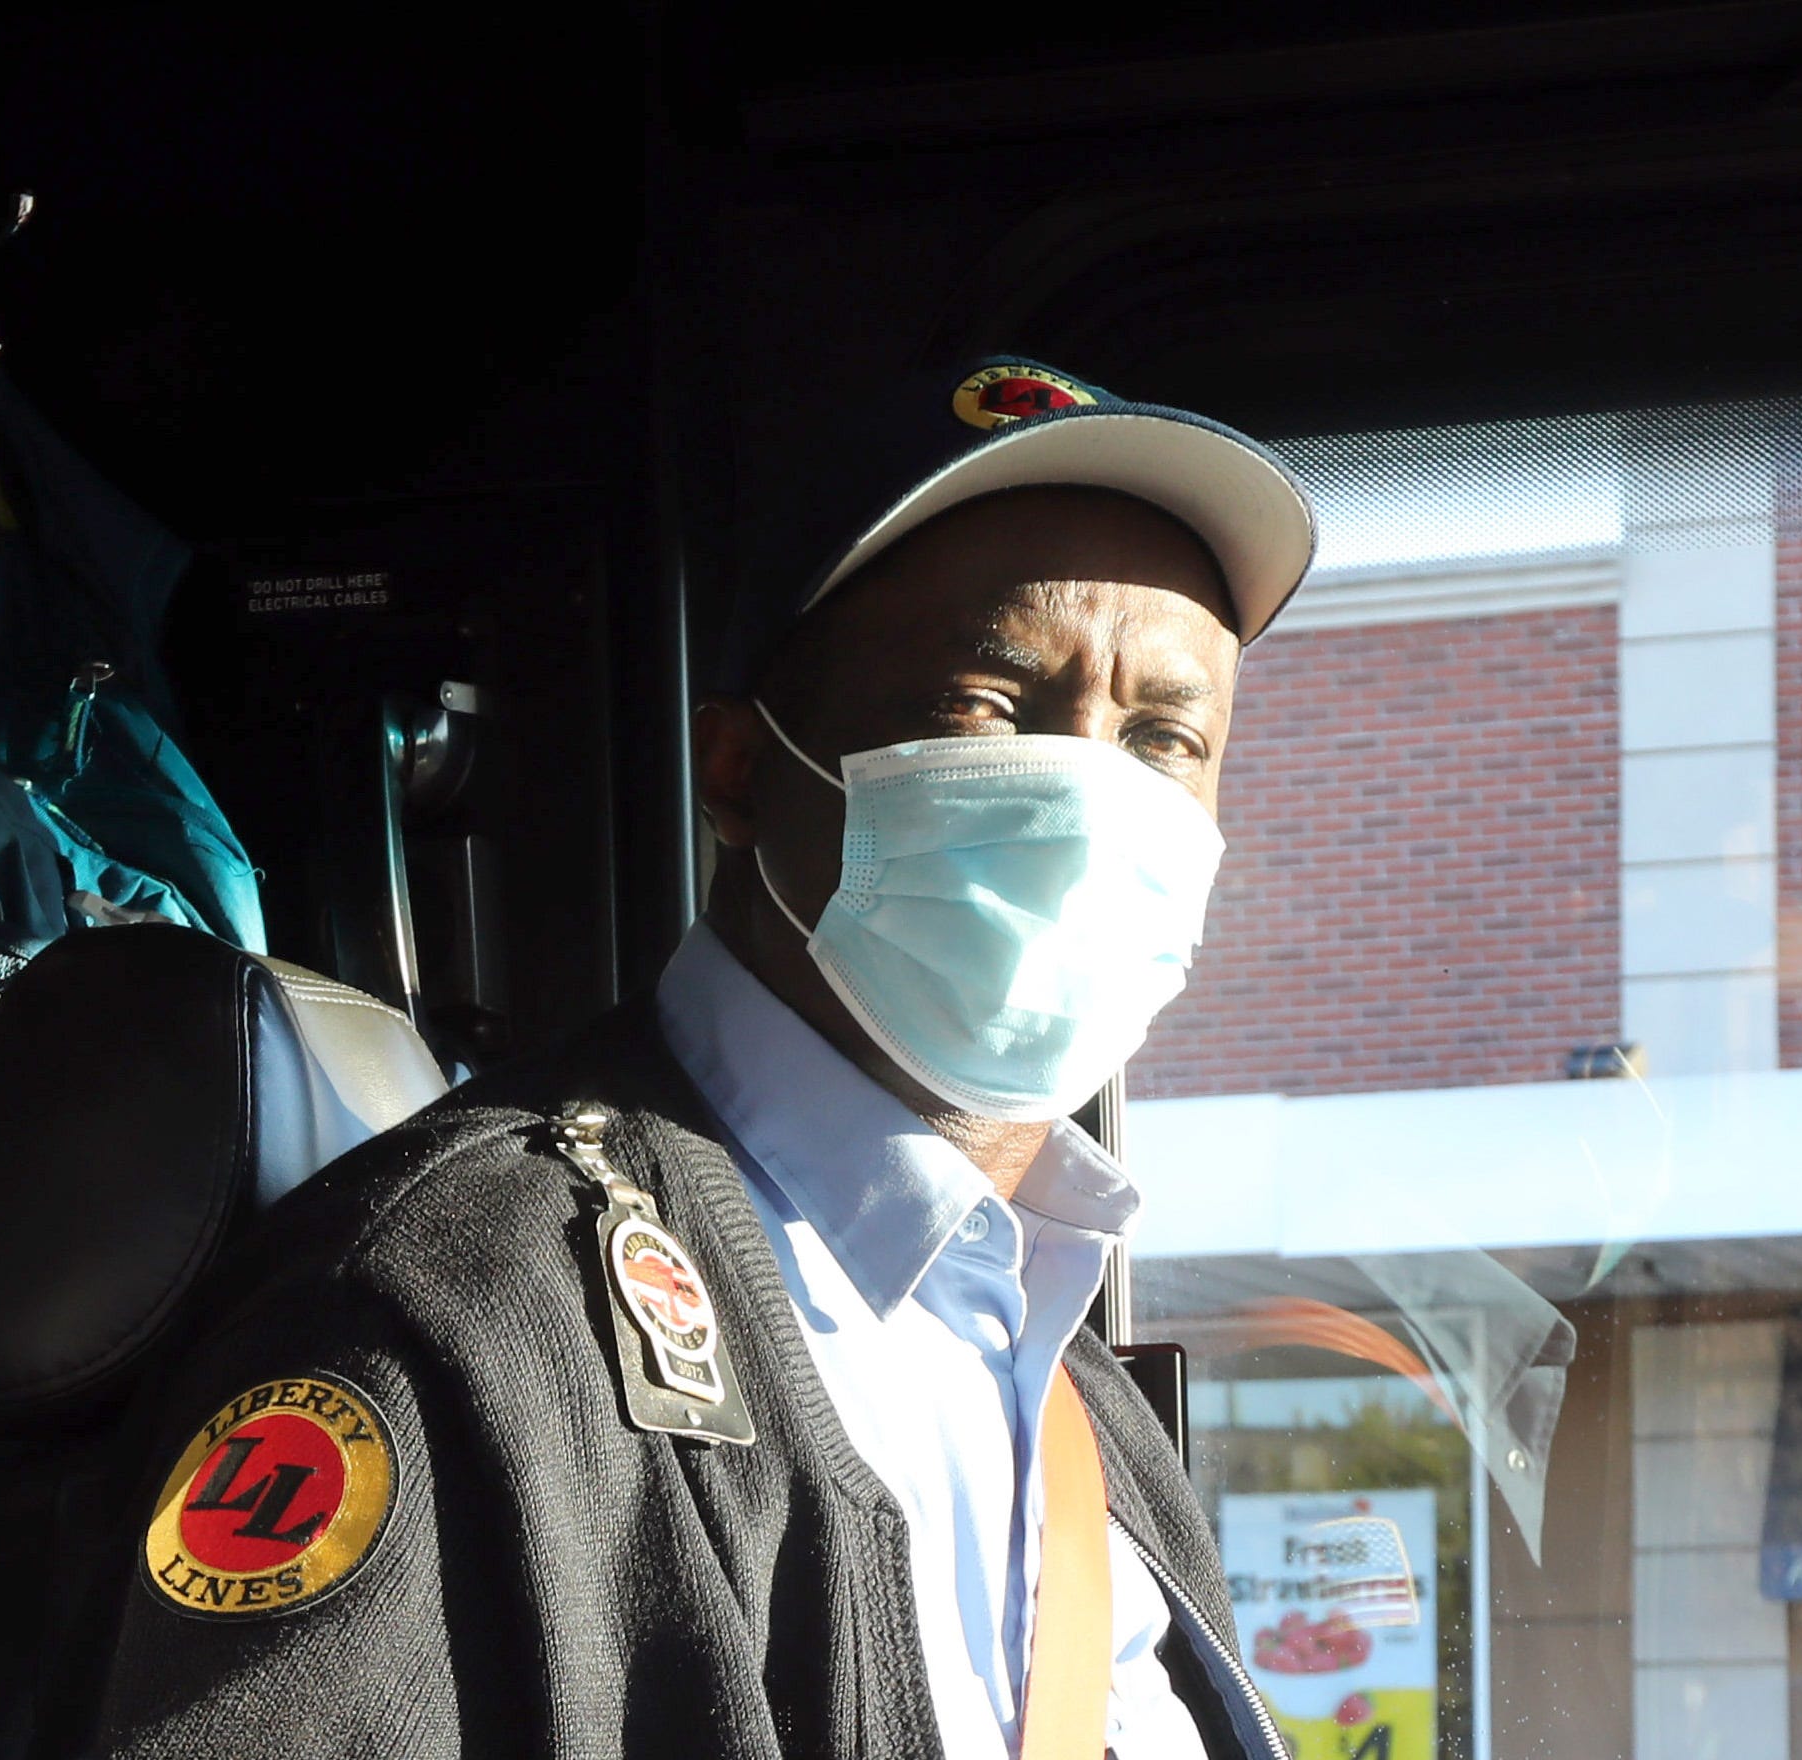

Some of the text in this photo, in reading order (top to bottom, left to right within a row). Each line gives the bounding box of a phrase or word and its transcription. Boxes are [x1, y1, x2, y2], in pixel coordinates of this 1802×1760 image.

[247, 590, 389, 613] ELECTRICAL CABLES
[275, 578, 302, 593] NOT
[305, 576, 344, 592] DRILL
[203, 1380, 376, 1448] LIBERTY
[184, 1437, 326, 1545] LL
[158, 1553, 304, 1608] LINES
